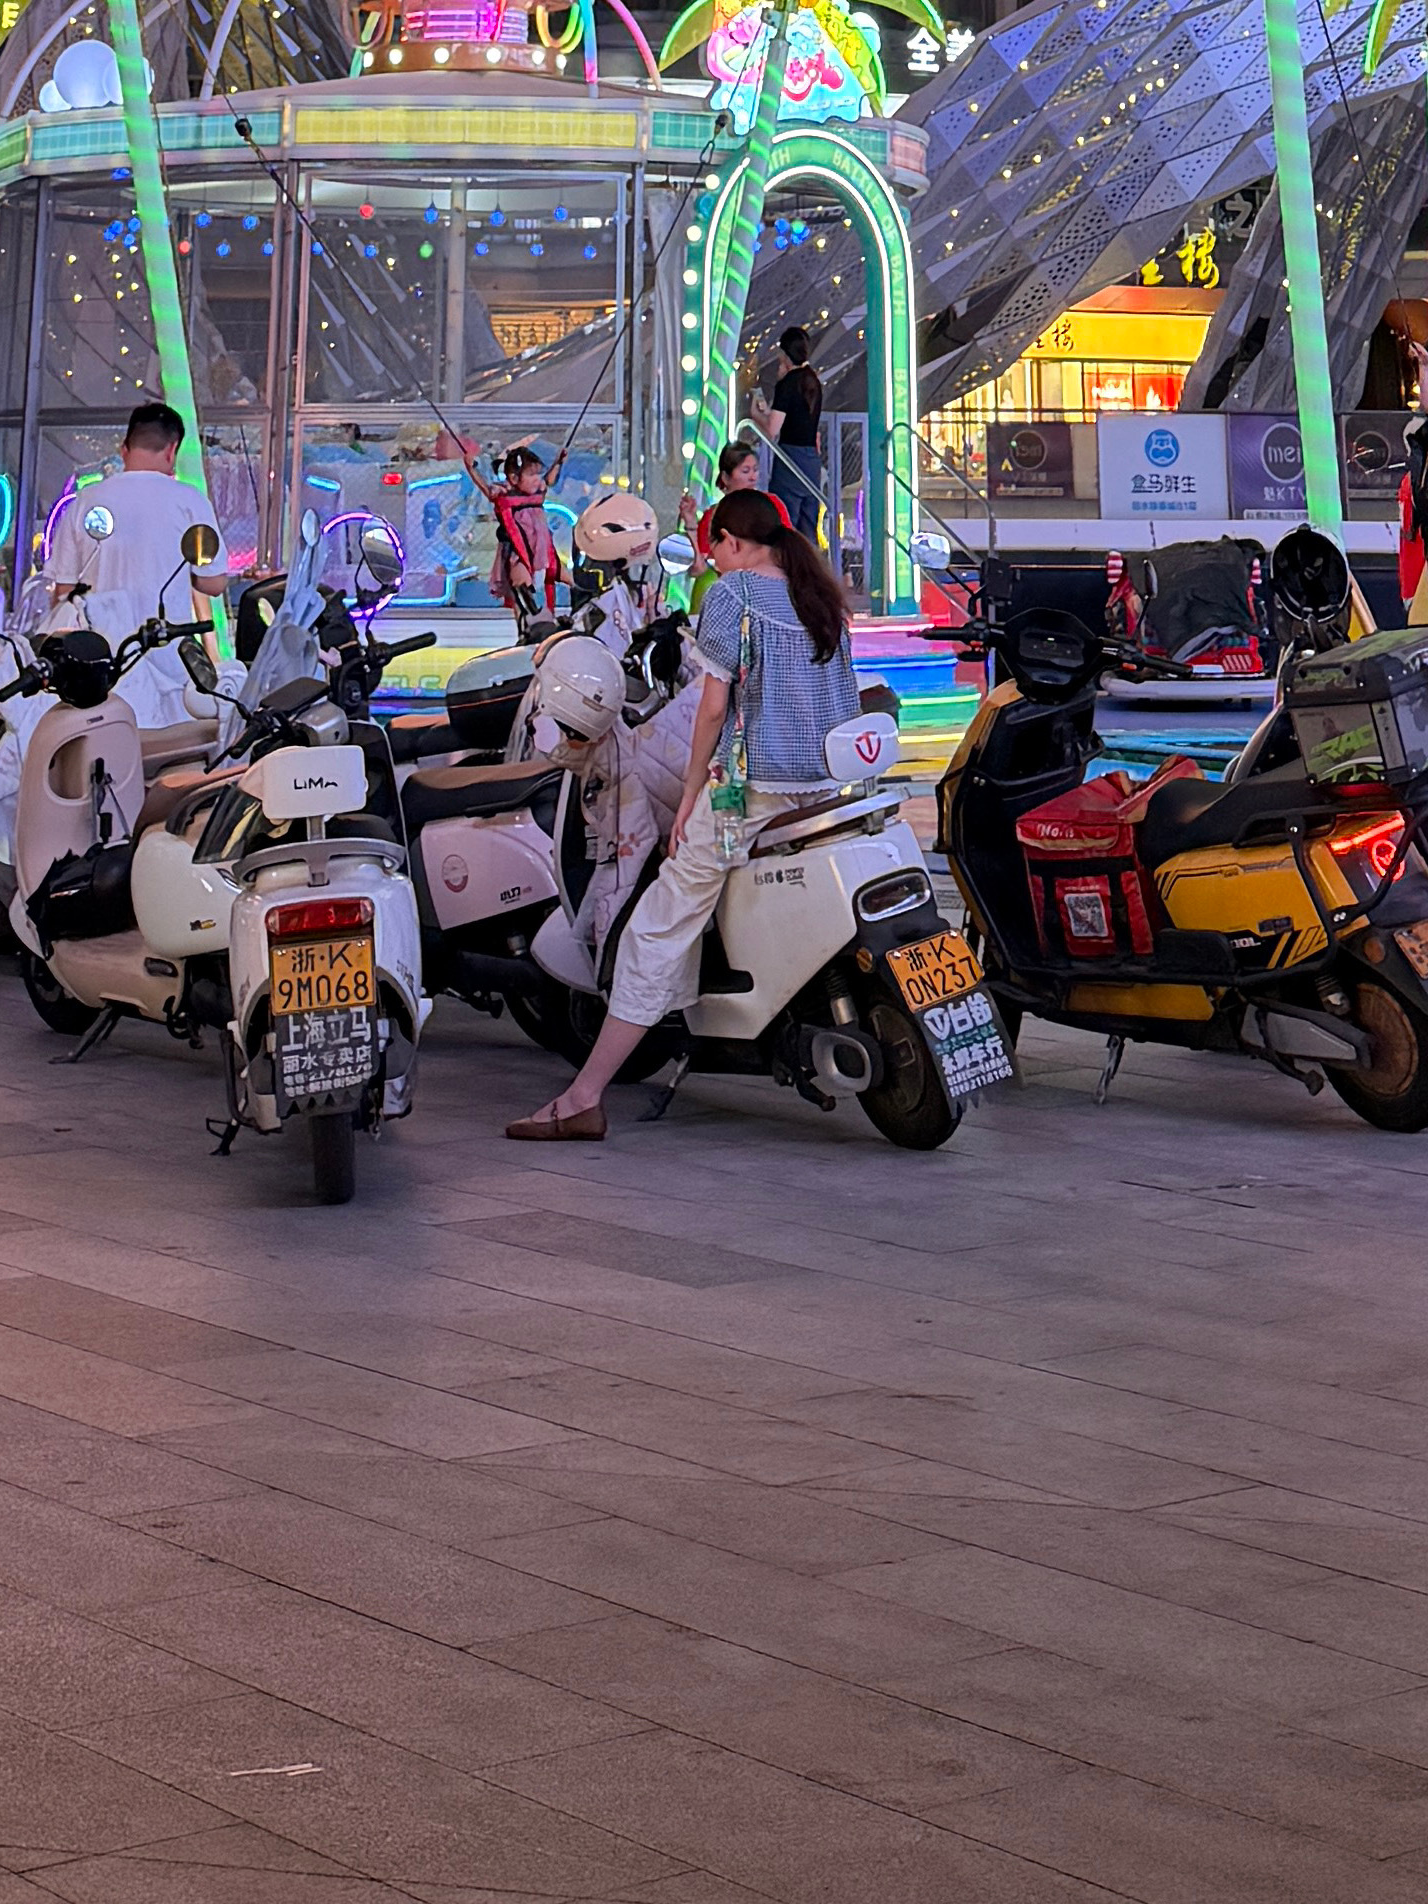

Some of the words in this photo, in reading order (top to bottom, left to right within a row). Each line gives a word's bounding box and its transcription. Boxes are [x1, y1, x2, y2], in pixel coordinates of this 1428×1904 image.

[890, 256, 907, 317] BATH
[1267, 445, 1302, 464] mei
[1130, 473, 1198, 494] 盒马鲜生
[291, 943, 353, 973] 浙·K
[903, 936, 956, 973] 浙·K
[278, 970, 370, 1010] 9M068
[905, 955, 978, 1006] 0N237
[281, 1005, 372, 1053] 上海立马
[947, 992, 994, 1035] 台铃
[281, 1044, 373, 1074] 丽水专卖店
